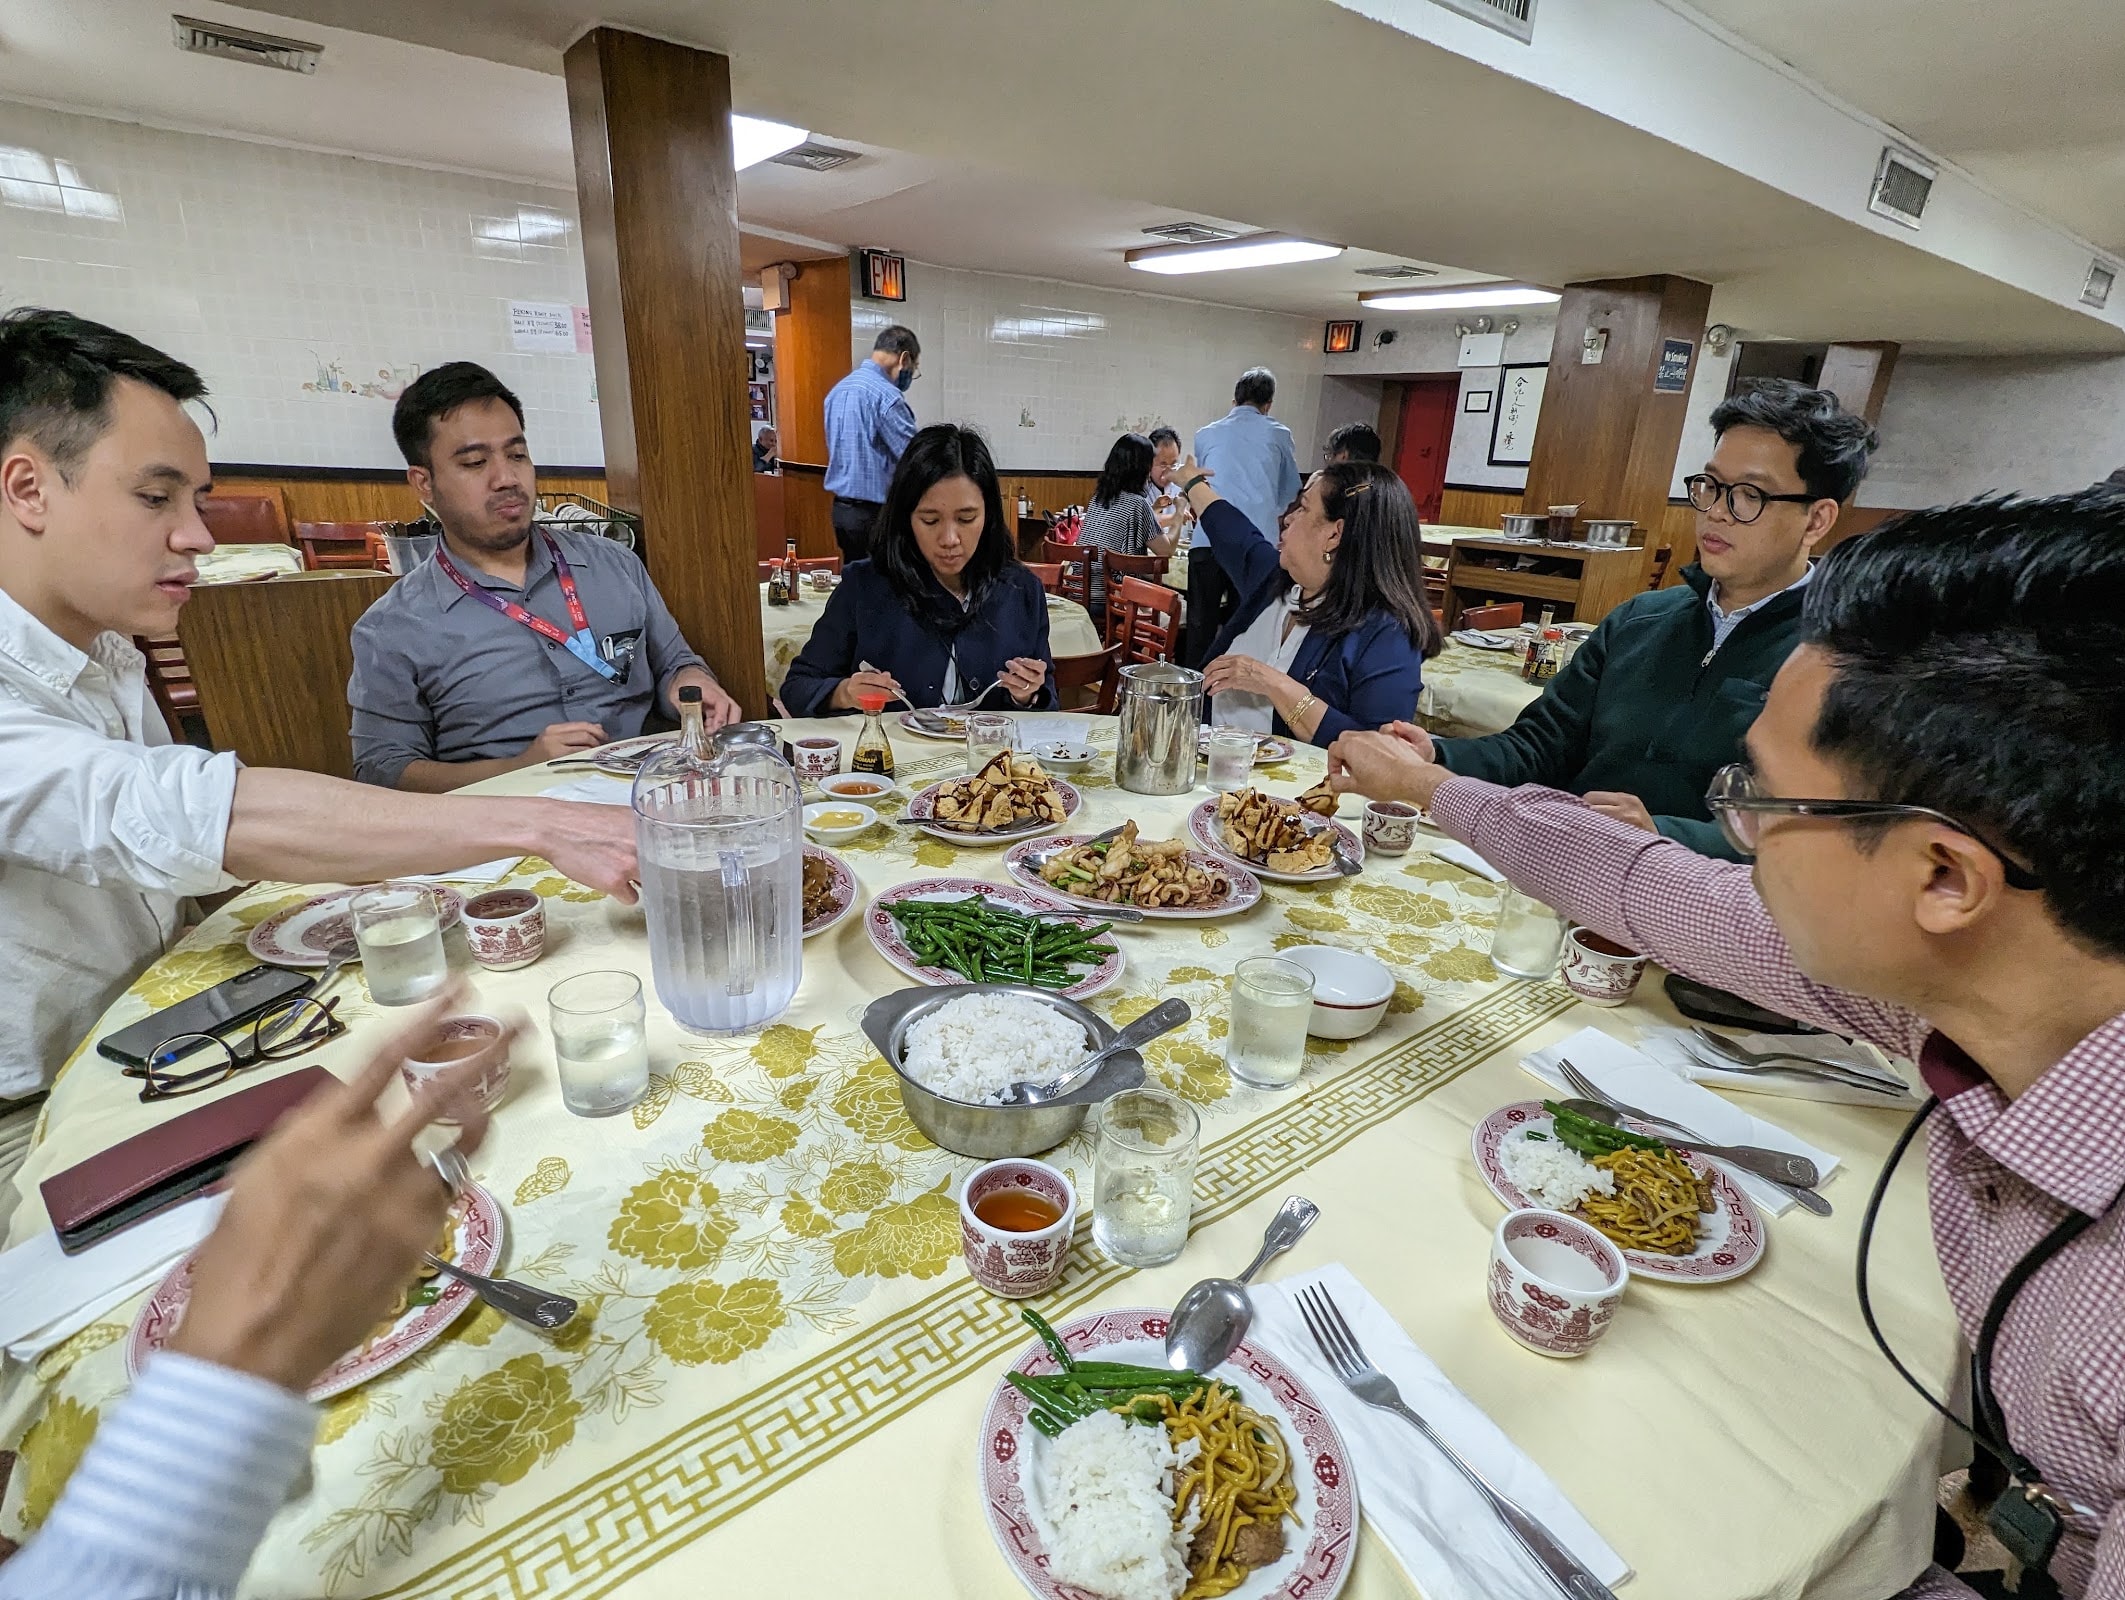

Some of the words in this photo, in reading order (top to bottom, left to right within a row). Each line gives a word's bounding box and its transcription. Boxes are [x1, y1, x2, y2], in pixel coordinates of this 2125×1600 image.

[872, 256, 900, 297] EXIT
[1329, 324, 1354, 350] EXIT
[1665, 351, 1671, 361] No
[1671, 352, 1688, 365] Smoking
